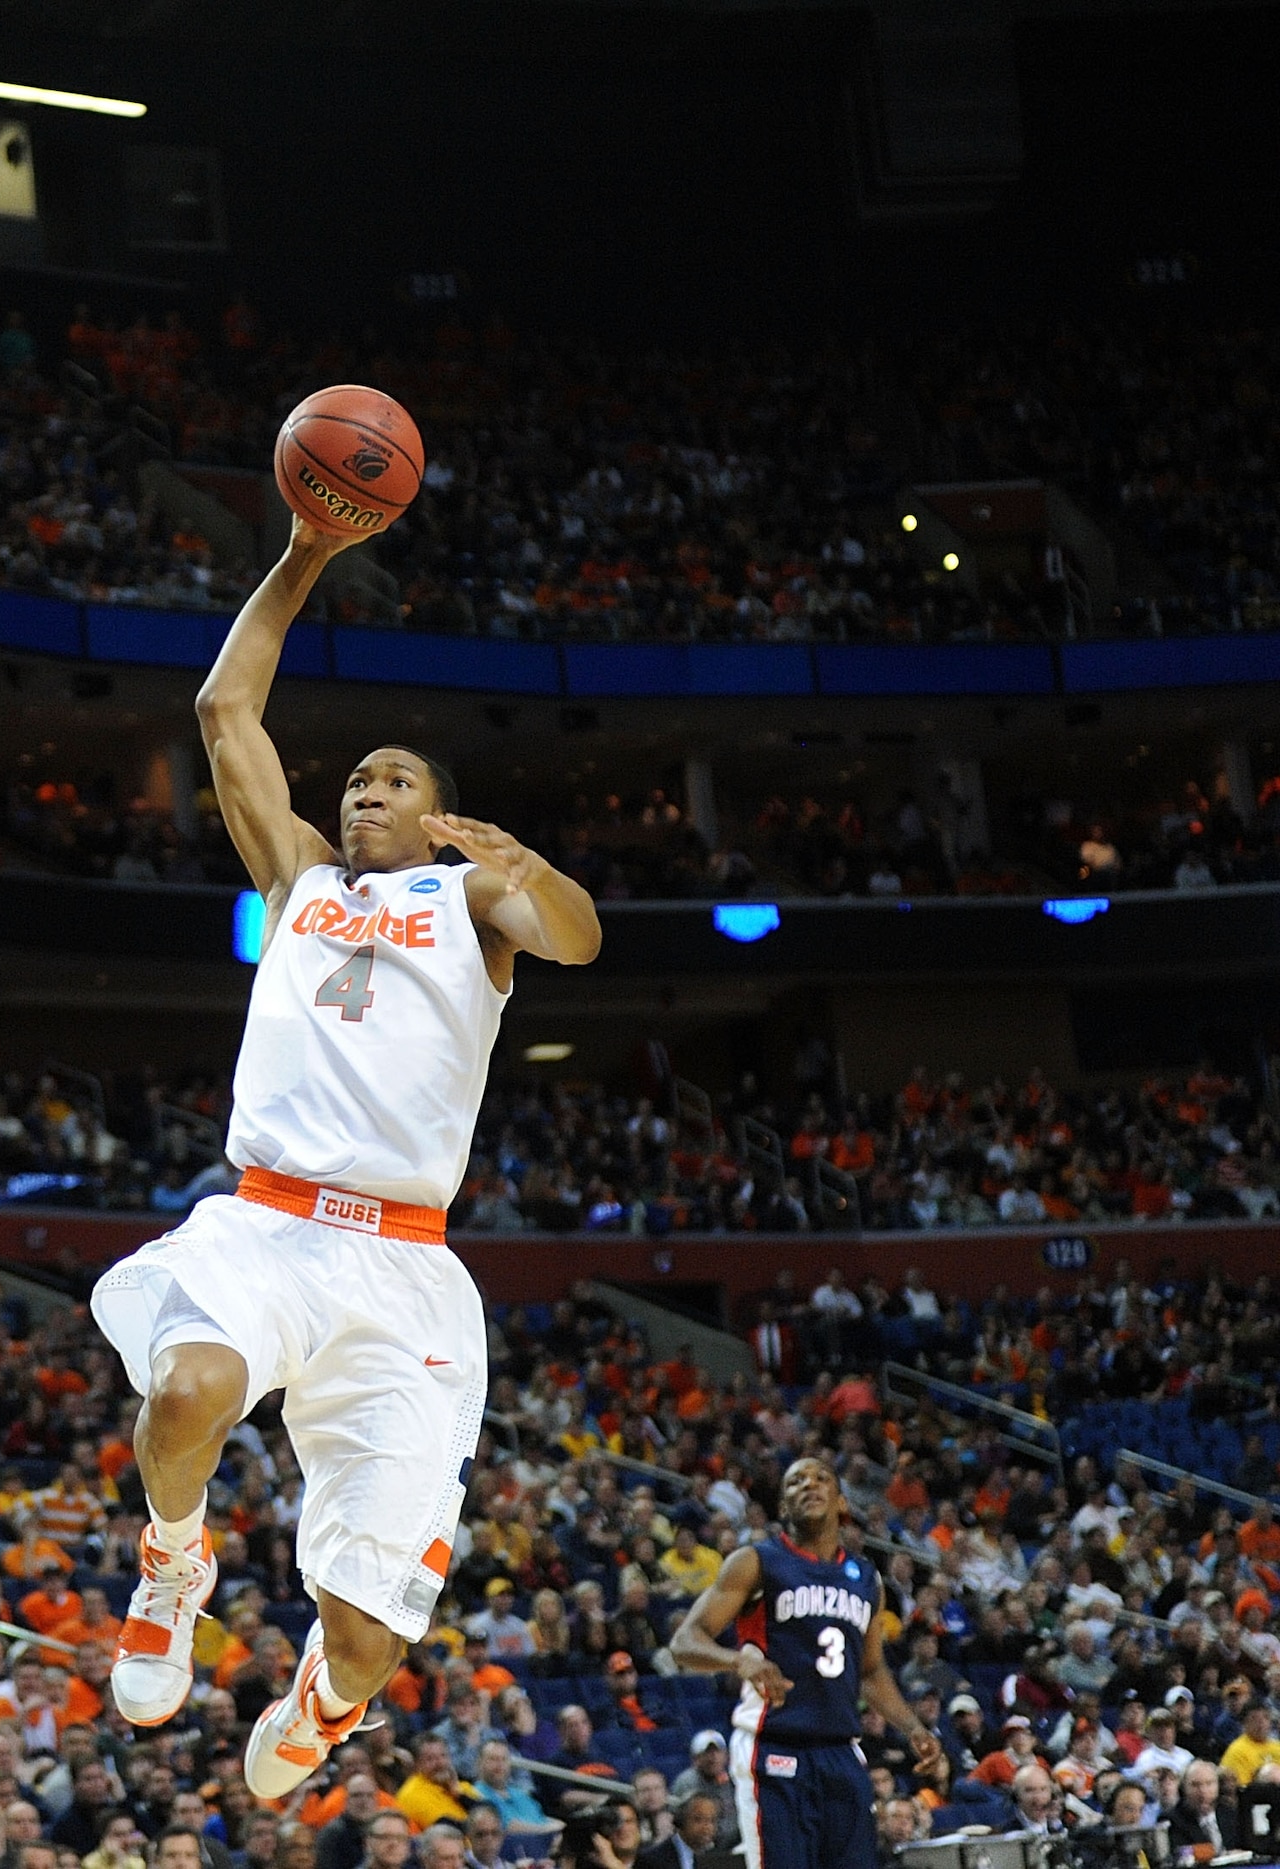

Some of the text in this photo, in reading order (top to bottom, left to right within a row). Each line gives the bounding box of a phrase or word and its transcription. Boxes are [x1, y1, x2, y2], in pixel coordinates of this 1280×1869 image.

[298, 464, 385, 527] Wilson
[291, 898, 436, 948] ORANGE
[314, 945, 375, 1022] 4
[815, 1626, 845, 1678] 3
